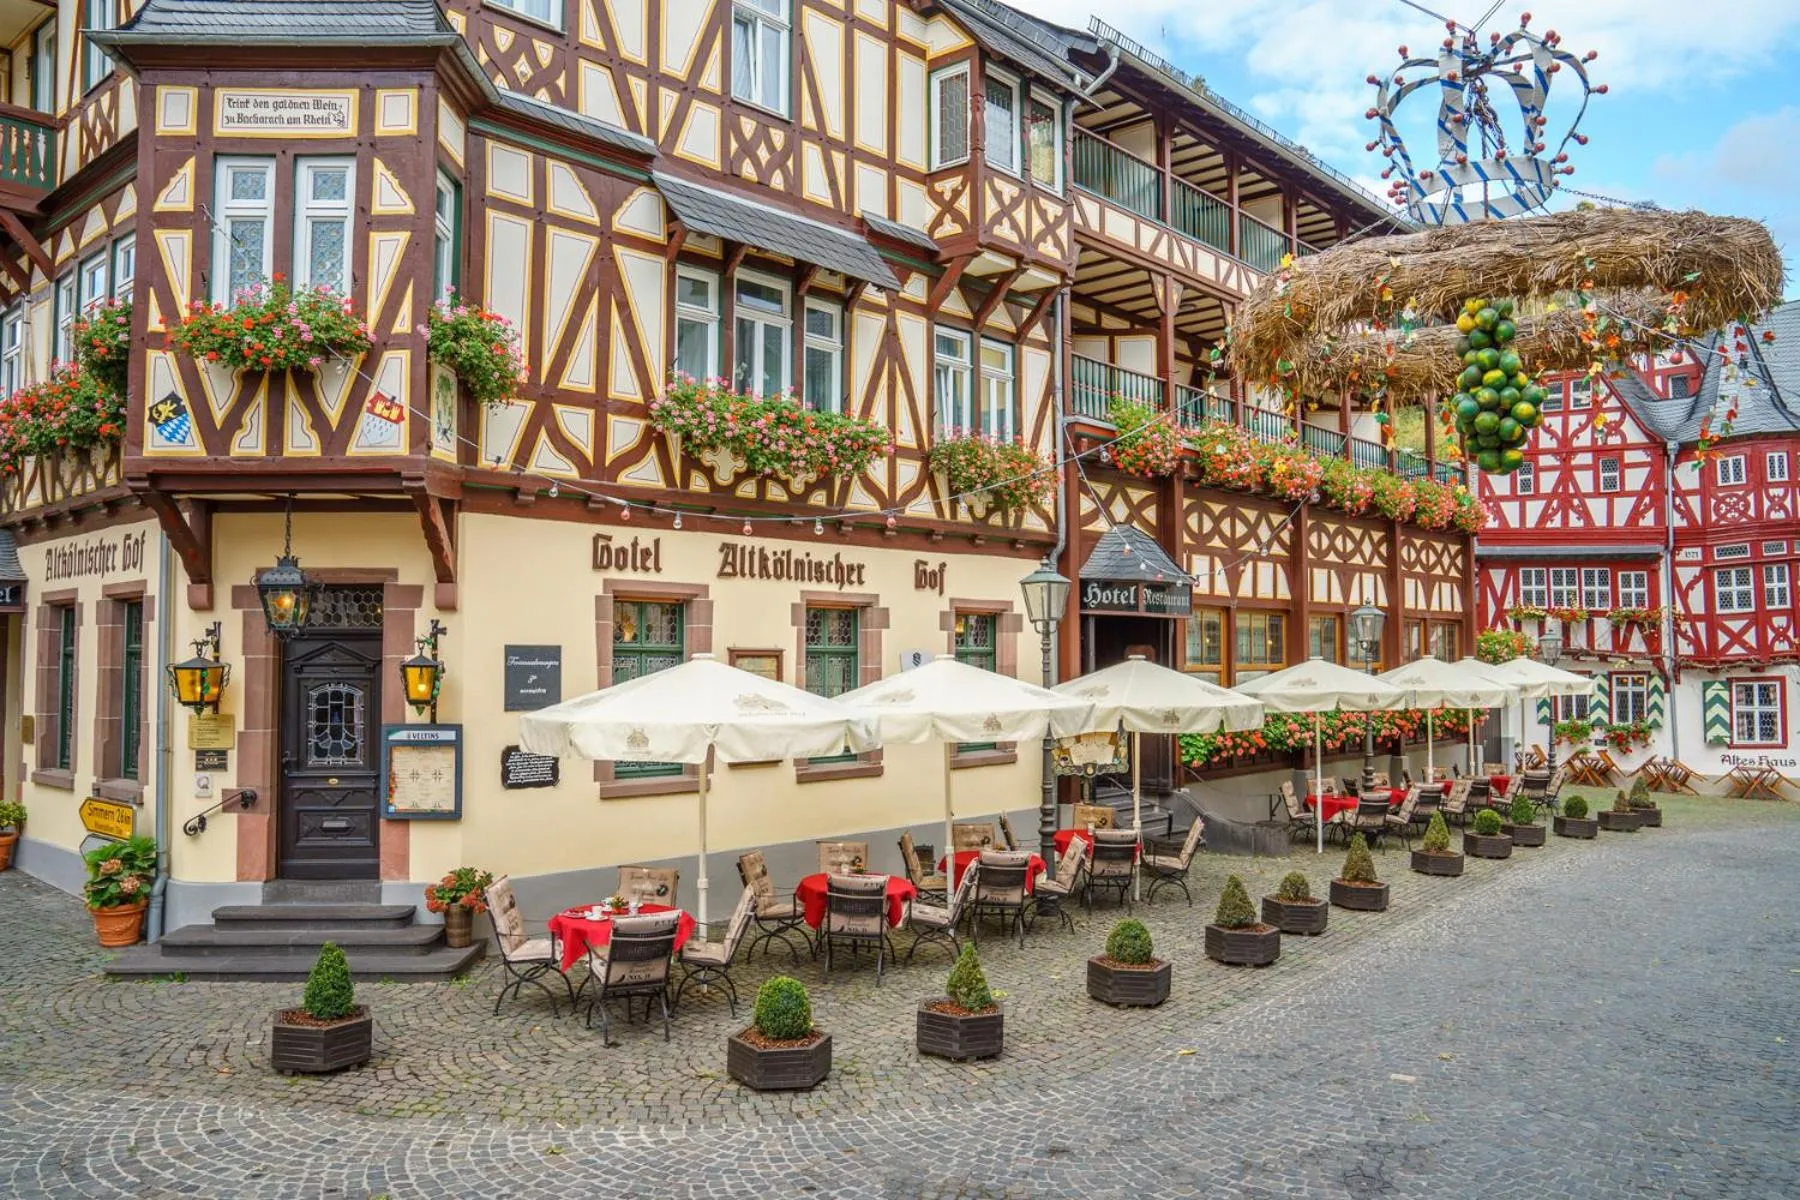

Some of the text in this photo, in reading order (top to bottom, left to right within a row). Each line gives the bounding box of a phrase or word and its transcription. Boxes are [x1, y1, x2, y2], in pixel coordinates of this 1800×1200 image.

[226, 97, 250, 109] Trink
[253, 98, 270, 109] den
[225, 115, 235, 124] zu
[287, 116, 301, 125] am
[303, 113, 331, 125] Rhein
[45, 529, 146, 582] Altkölnischer Hof
[591, 532, 949, 597] Hotel Altkölnischer Hof
[1083, 582, 1189, 608] Hotel Restaurant
[1720, 753, 1797, 768] Altes Haus
